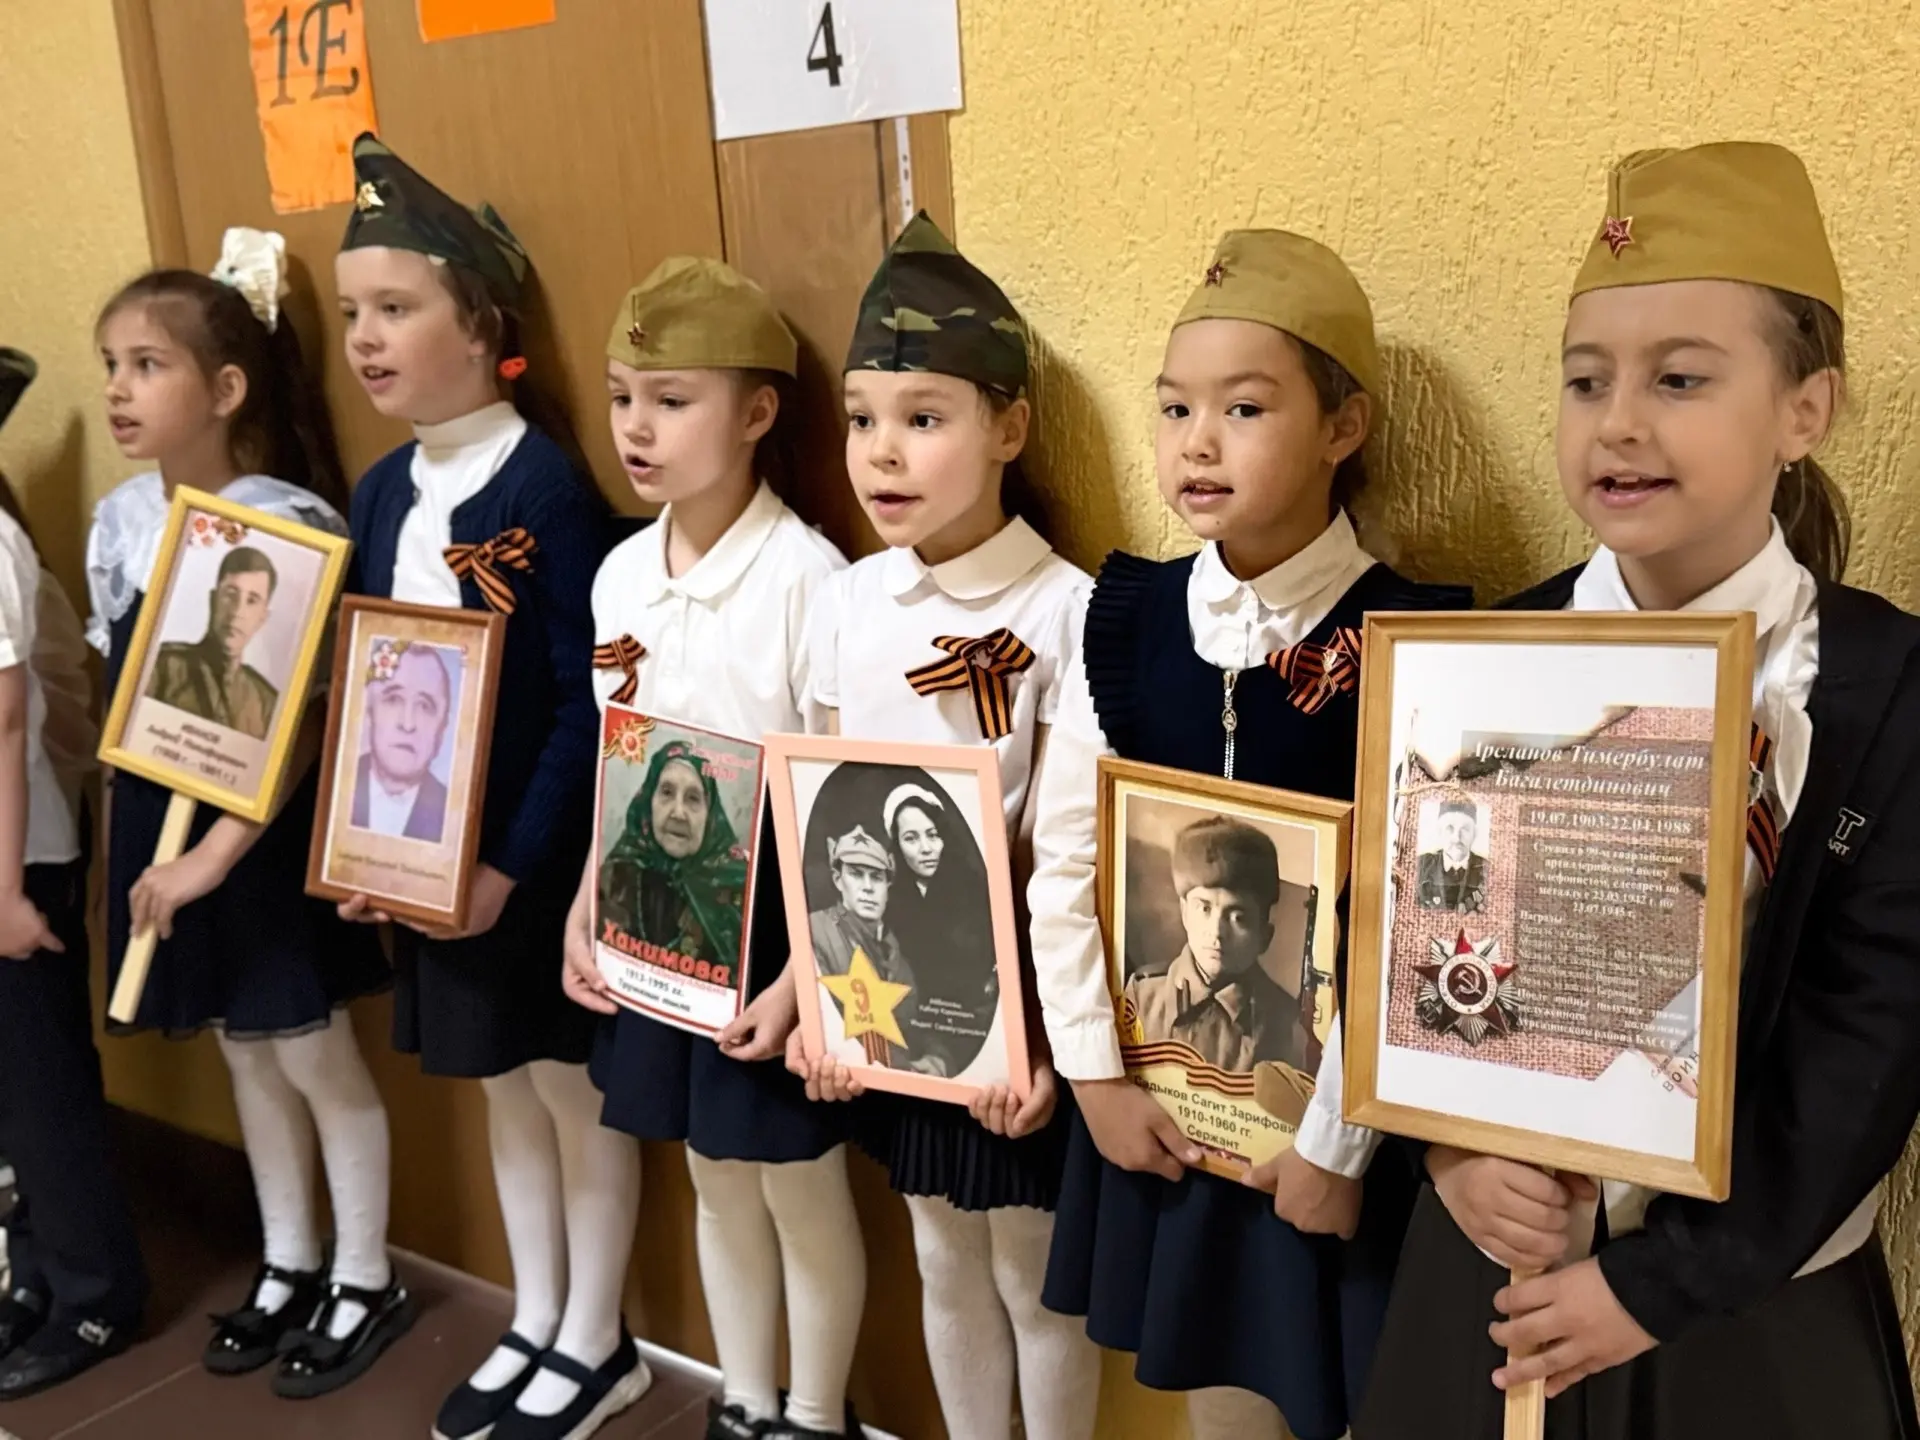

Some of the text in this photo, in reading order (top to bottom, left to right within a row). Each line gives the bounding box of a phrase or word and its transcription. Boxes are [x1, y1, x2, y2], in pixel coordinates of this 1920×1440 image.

[806, 1, 843, 87] 4
[603, 918, 730, 986] Хакимова
[850, 978, 870, 1013] 9
[1177, 1104, 1236, 1133] 1910-1960
[1191, 1093, 1226, 1114] Сагит
[1230, 1104, 1298, 1136] Зарифови
[1187, 1124, 1240, 1150] Сержант
